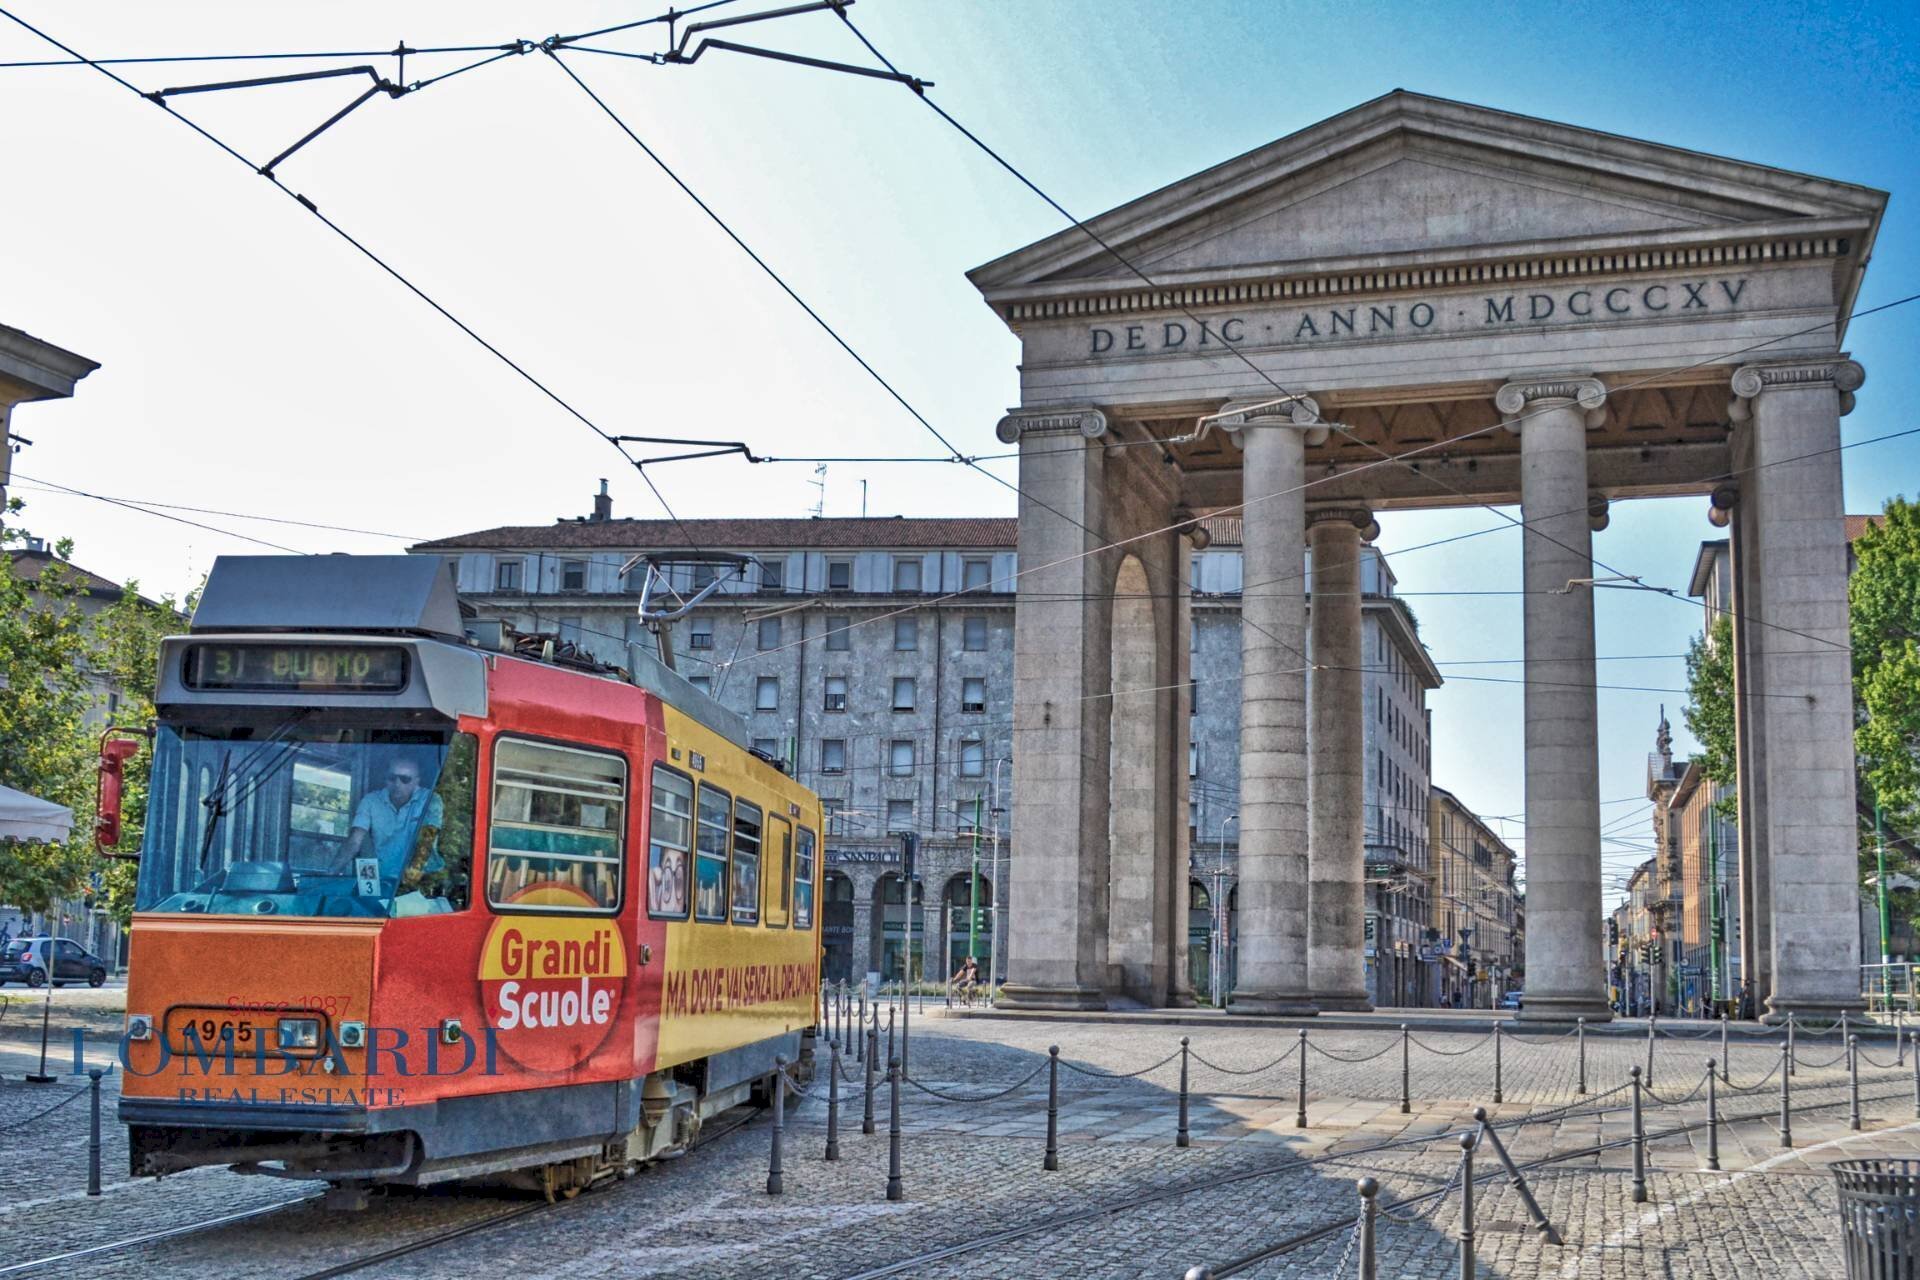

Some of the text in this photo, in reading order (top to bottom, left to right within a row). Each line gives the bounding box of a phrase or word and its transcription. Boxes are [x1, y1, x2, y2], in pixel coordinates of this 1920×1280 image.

[1090, 278, 1748, 353] DEDIC ANNO MDCCCXV
[273, 652, 370, 678] DUOMO
[366, 881, 374, 895] 3
[500, 928, 611, 980] Grandi
[667, 970, 687, 1019] MA
[690, 967, 725, 1015] DOVE
[726, 966, 743, 1010] VAI
[743, 965, 771, 1006] SENZA
[773, 965, 780, 1001] IL
[182, 1020, 253, 1042] 4965
